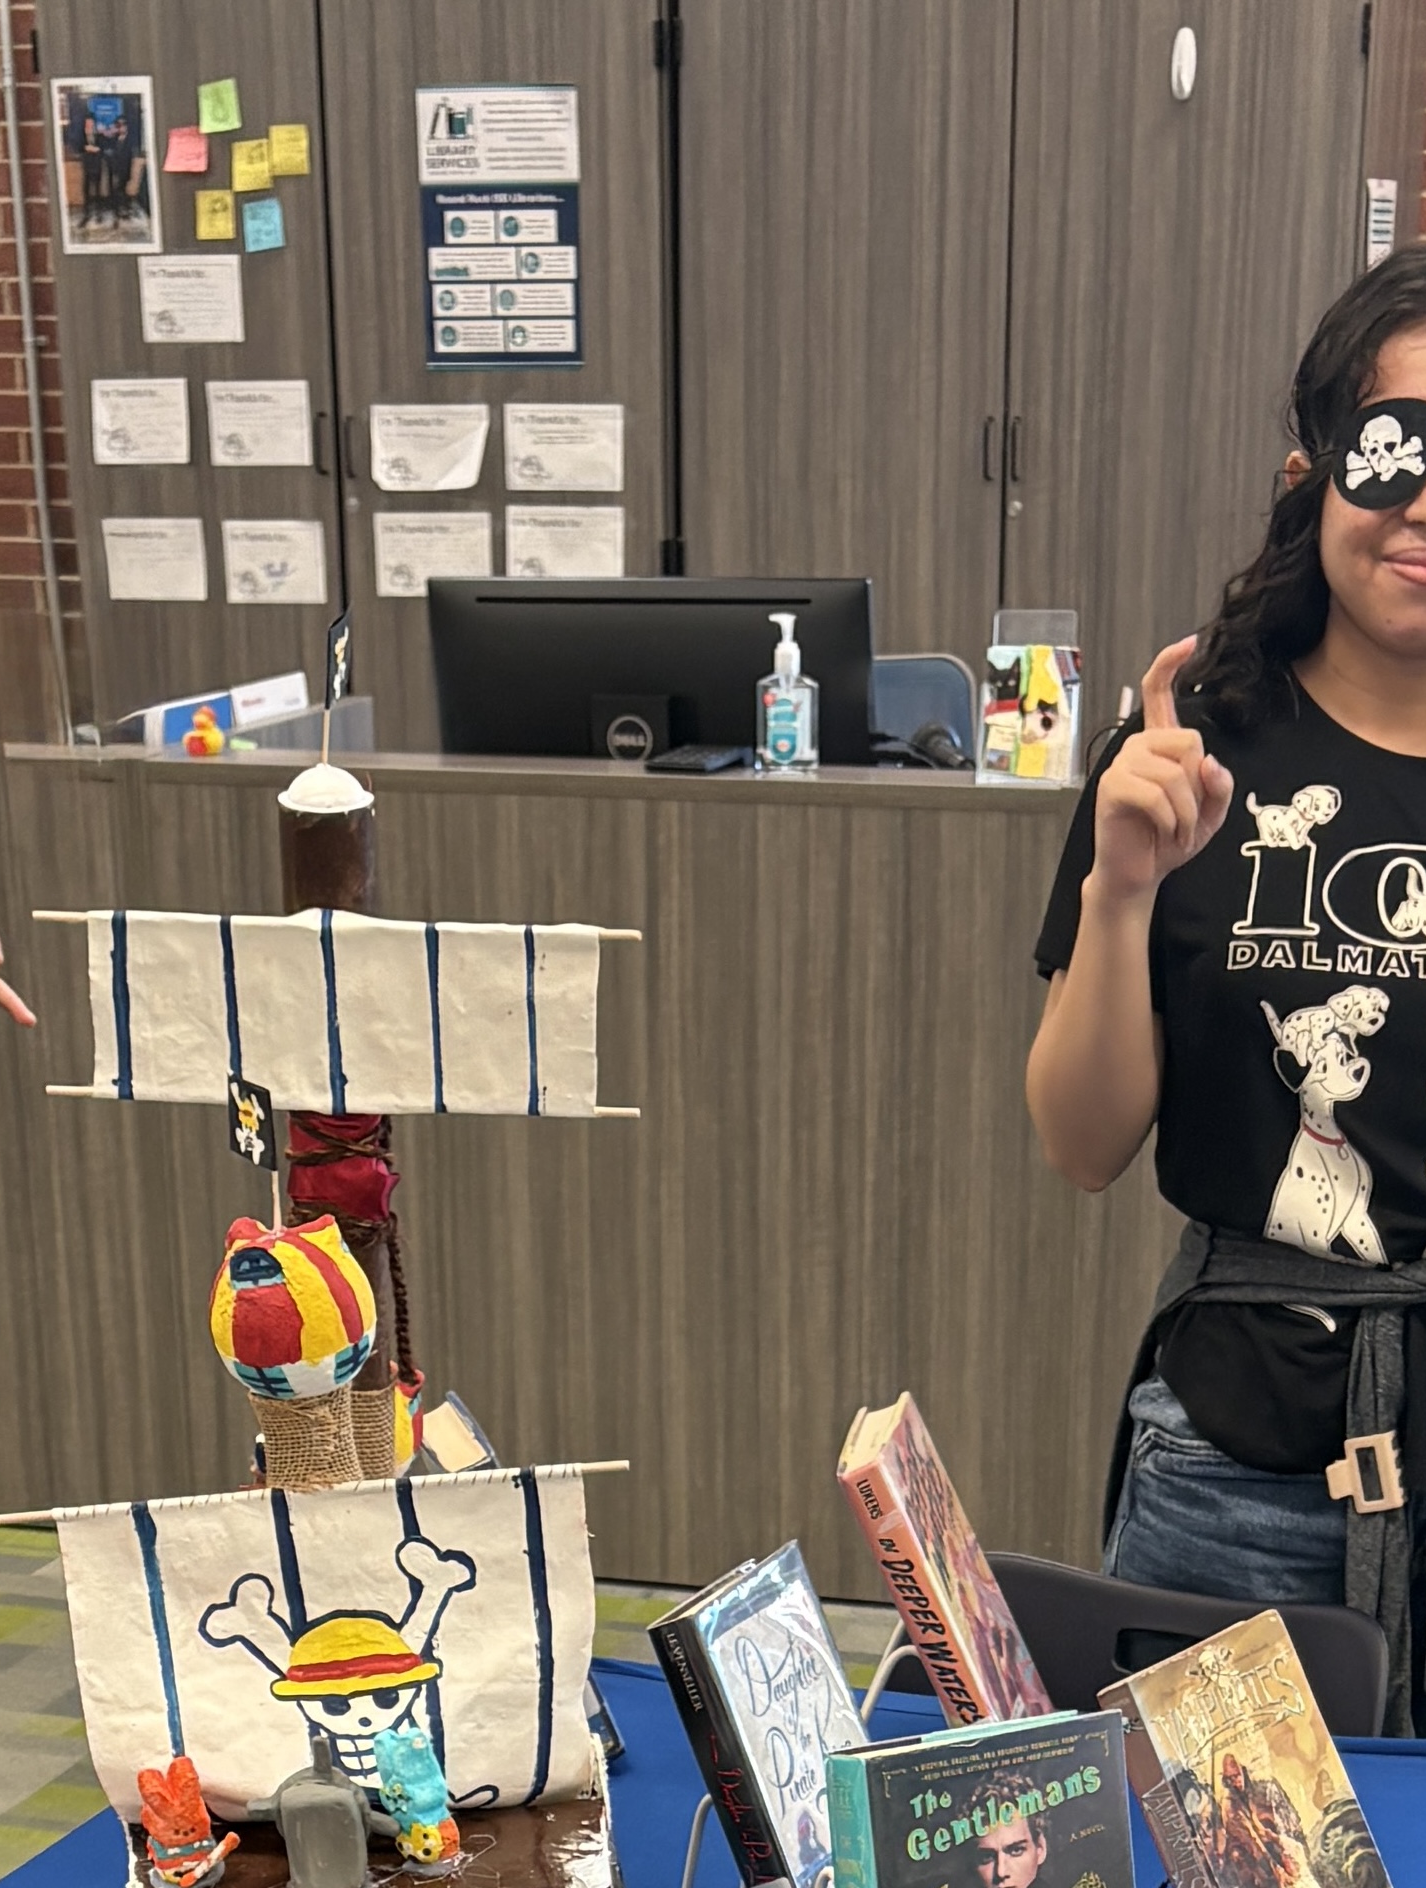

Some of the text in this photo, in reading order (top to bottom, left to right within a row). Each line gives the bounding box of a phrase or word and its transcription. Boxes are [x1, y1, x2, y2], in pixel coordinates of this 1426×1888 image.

[857, 1479, 883, 1520] LUKENS
[666, 1632, 703, 1713] LEVENSELLER
[878, 1538, 985, 1725] IN DEEPER WATERS
[735, 1632, 823, 1717] Daughter
[765, 1726, 819, 1819] Pirate
[907, 1765, 1102, 1861] Gentleman's
[909, 1788, 952, 1820] The
[1079, 1823, 1106, 1839] NOVEL
